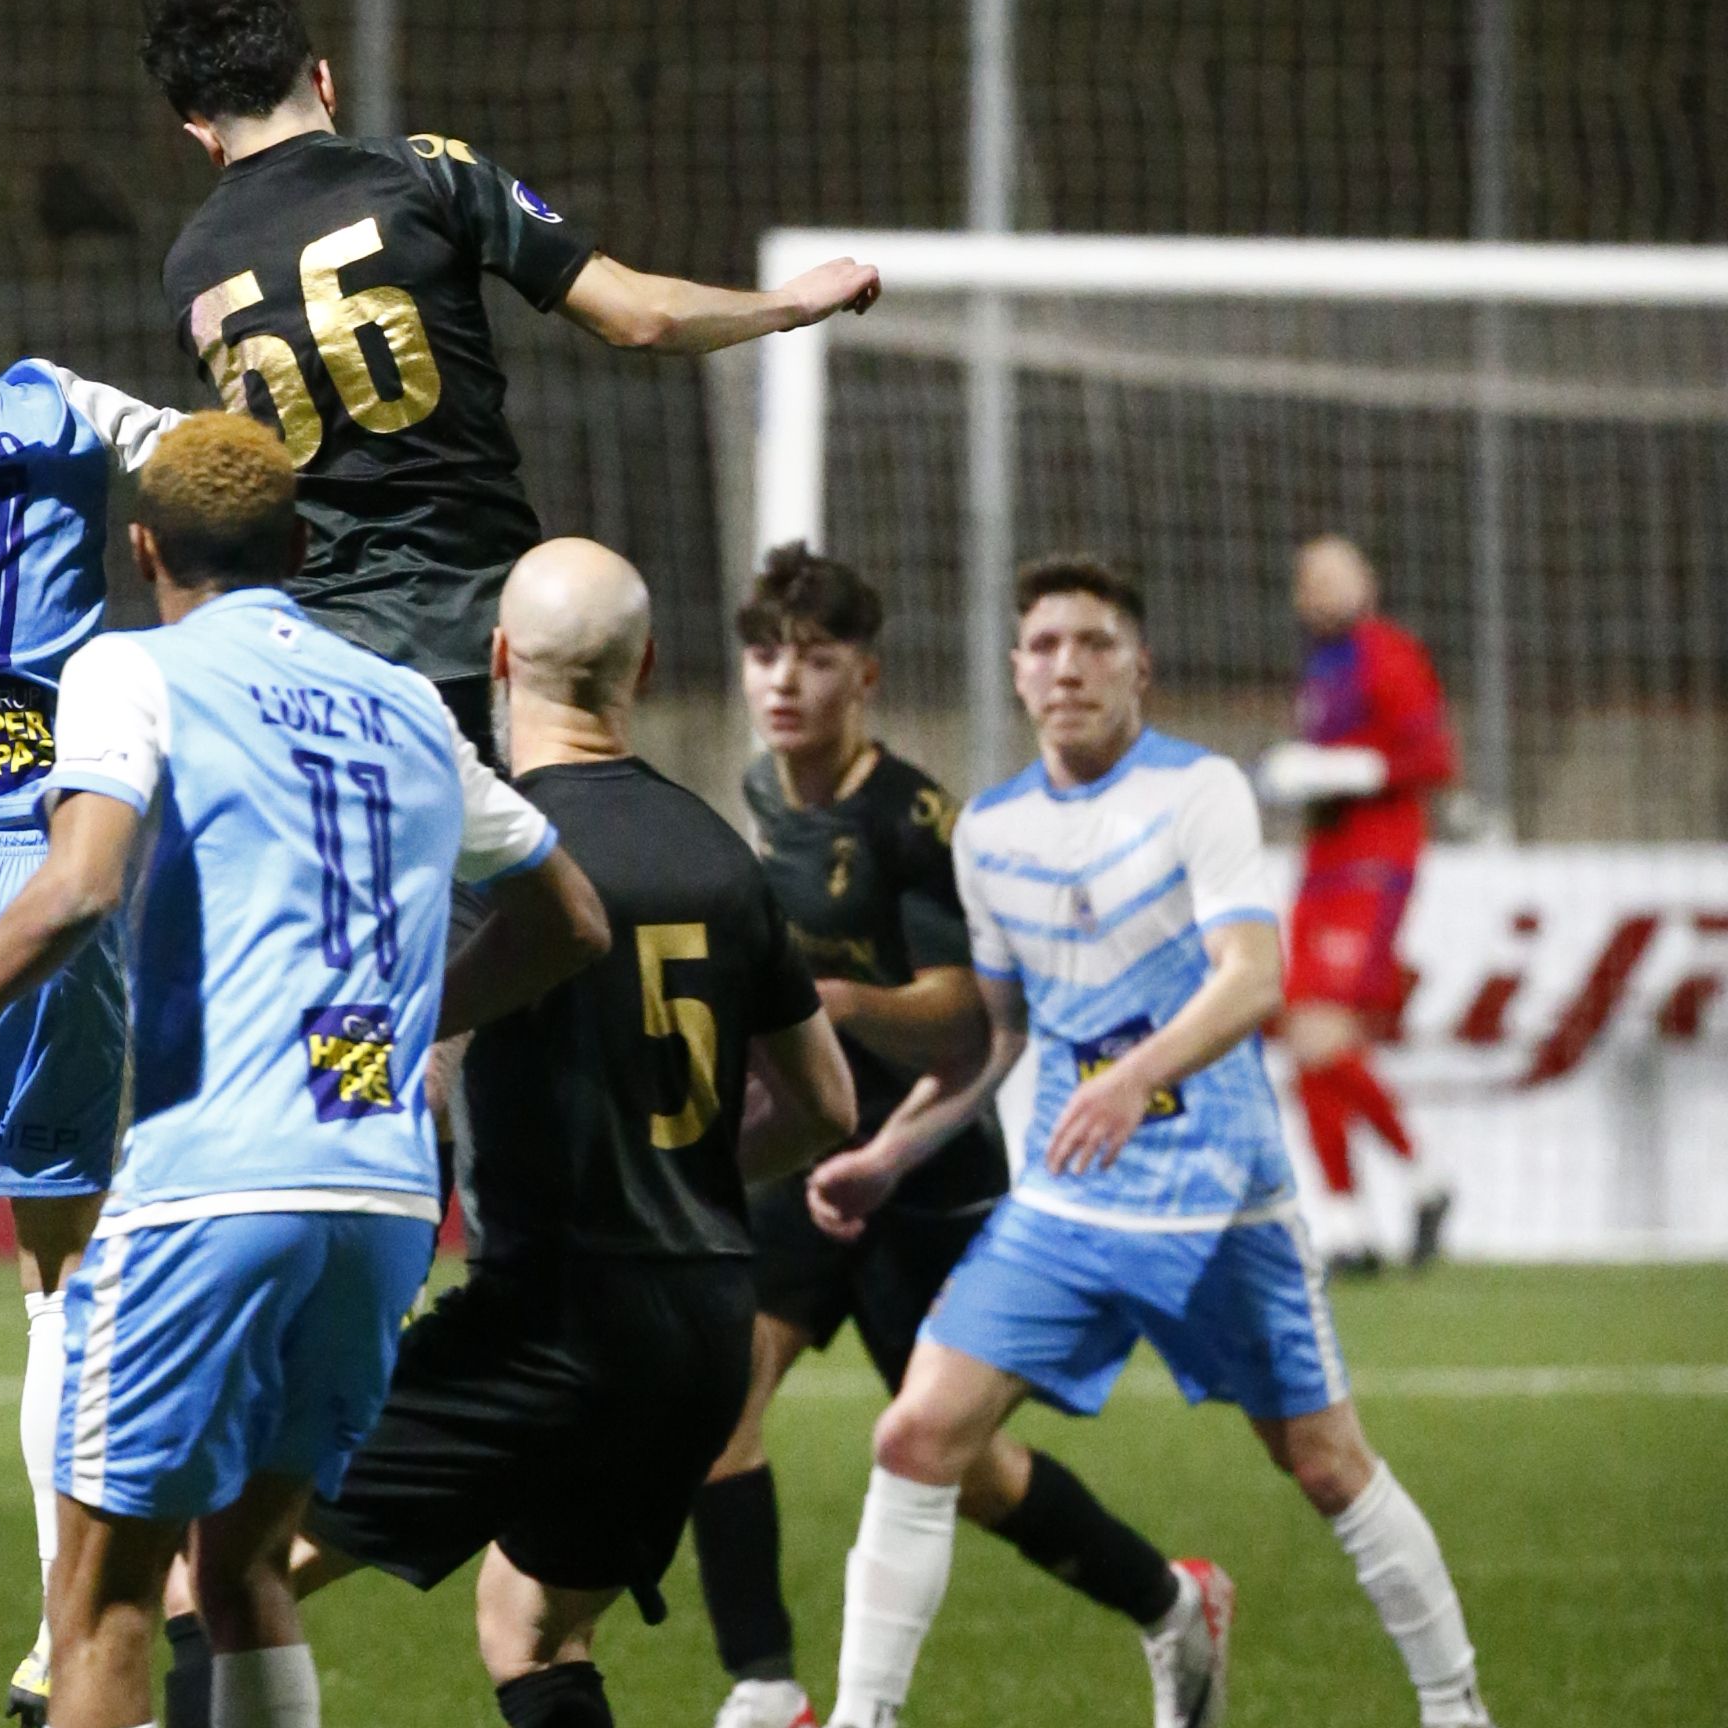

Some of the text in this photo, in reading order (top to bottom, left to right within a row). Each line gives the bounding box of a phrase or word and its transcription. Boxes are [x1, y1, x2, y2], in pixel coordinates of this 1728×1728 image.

[189, 216, 442, 471] 56
[249, 684, 347, 739] LUIZ
[635, 921, 721, 1150] 5
